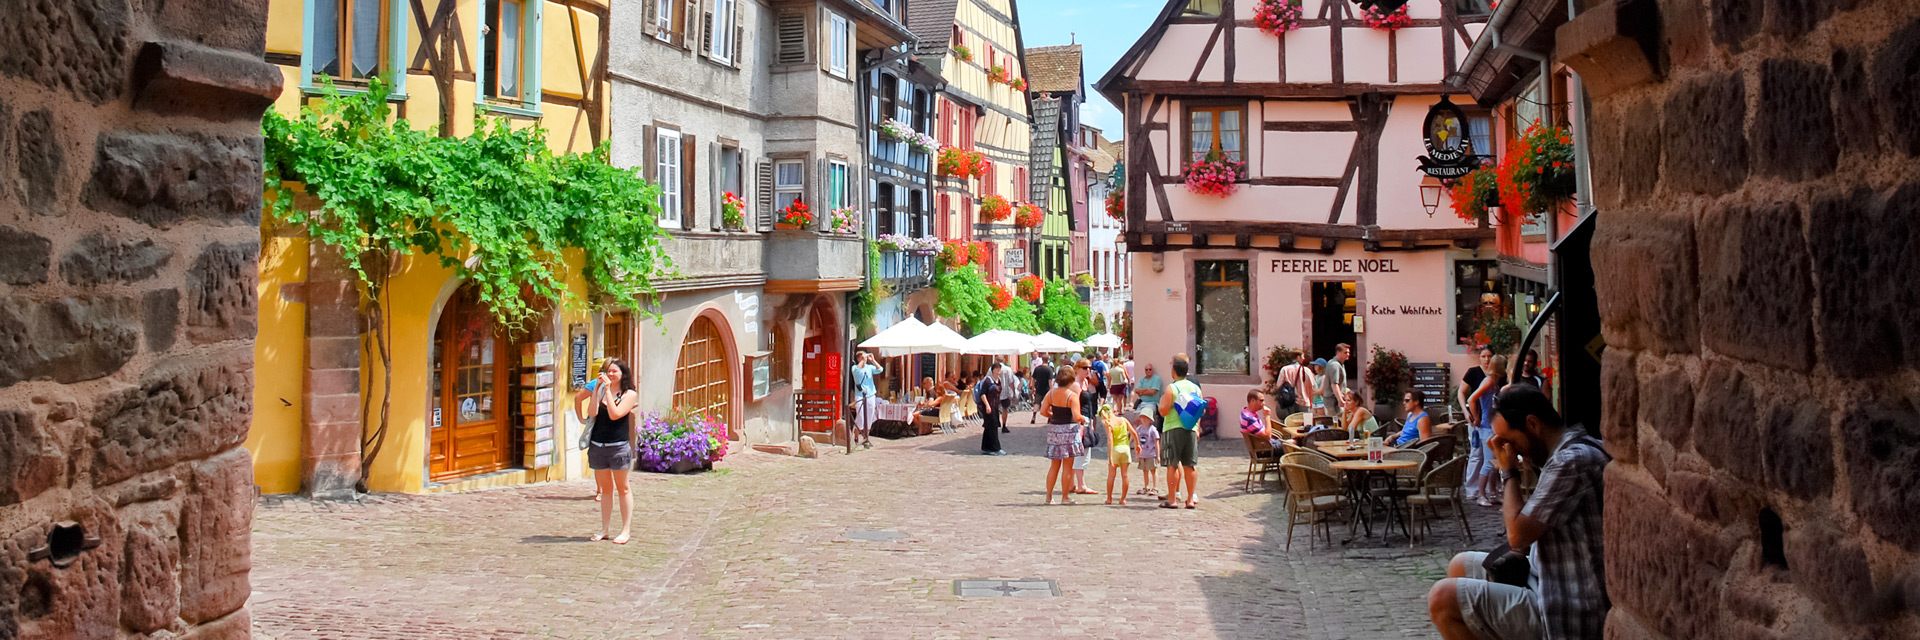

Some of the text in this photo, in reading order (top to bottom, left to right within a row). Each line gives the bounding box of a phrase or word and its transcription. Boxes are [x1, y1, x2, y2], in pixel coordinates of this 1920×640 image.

[1430, 138, 1469, 161] MEDIEVAL
[1427, 166, 1469, 176] RESTAURANT
[1271, 259, 1399, 273] FEERIE DE NOEL
[1399, 305, 1442, 315] Wohlfahrt
